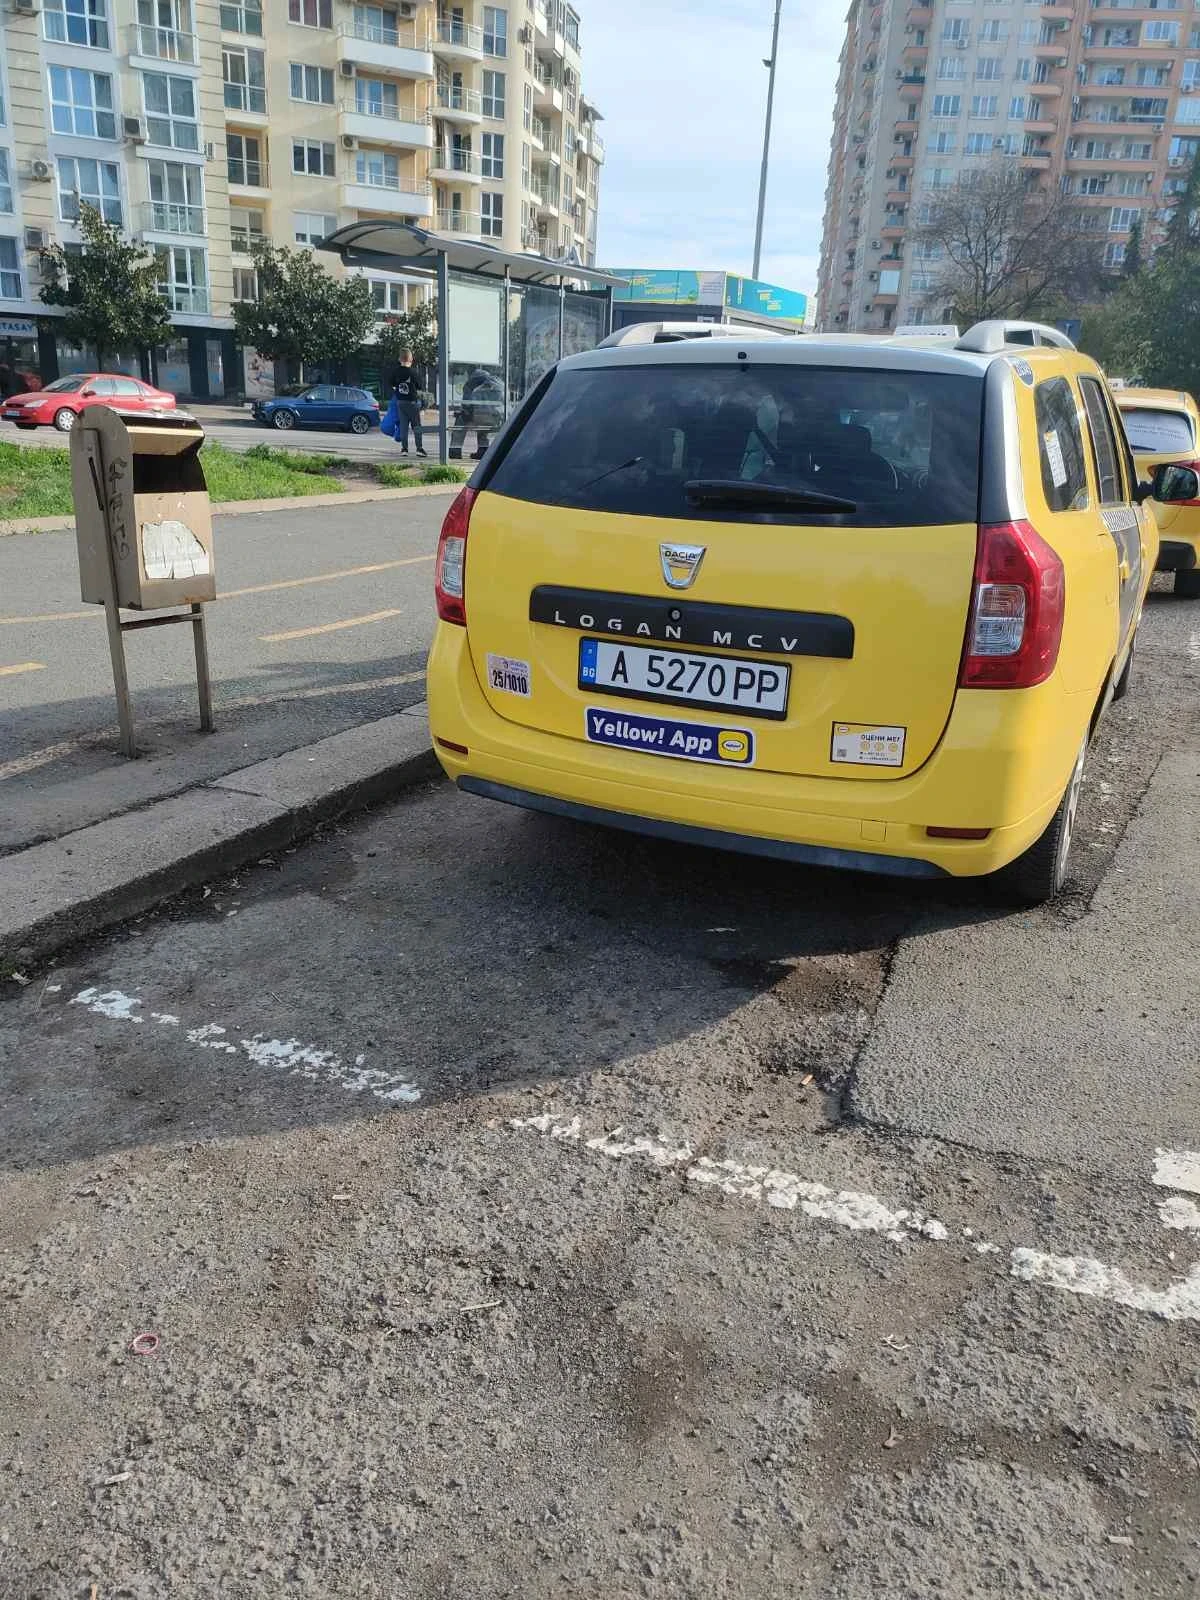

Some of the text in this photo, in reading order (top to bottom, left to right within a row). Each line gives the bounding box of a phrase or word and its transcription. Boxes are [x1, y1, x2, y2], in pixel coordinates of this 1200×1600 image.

[664, 550, 696, 559] DACIA
[554, 610, 799, 651] LOGAN MCV
[492, 669, 528, 694] 25/1010
[583, 666, 595, 678] BG
[611, 650, 780, 703] A 5270 PP
[593, 716, 712, 754] Yellow! App
